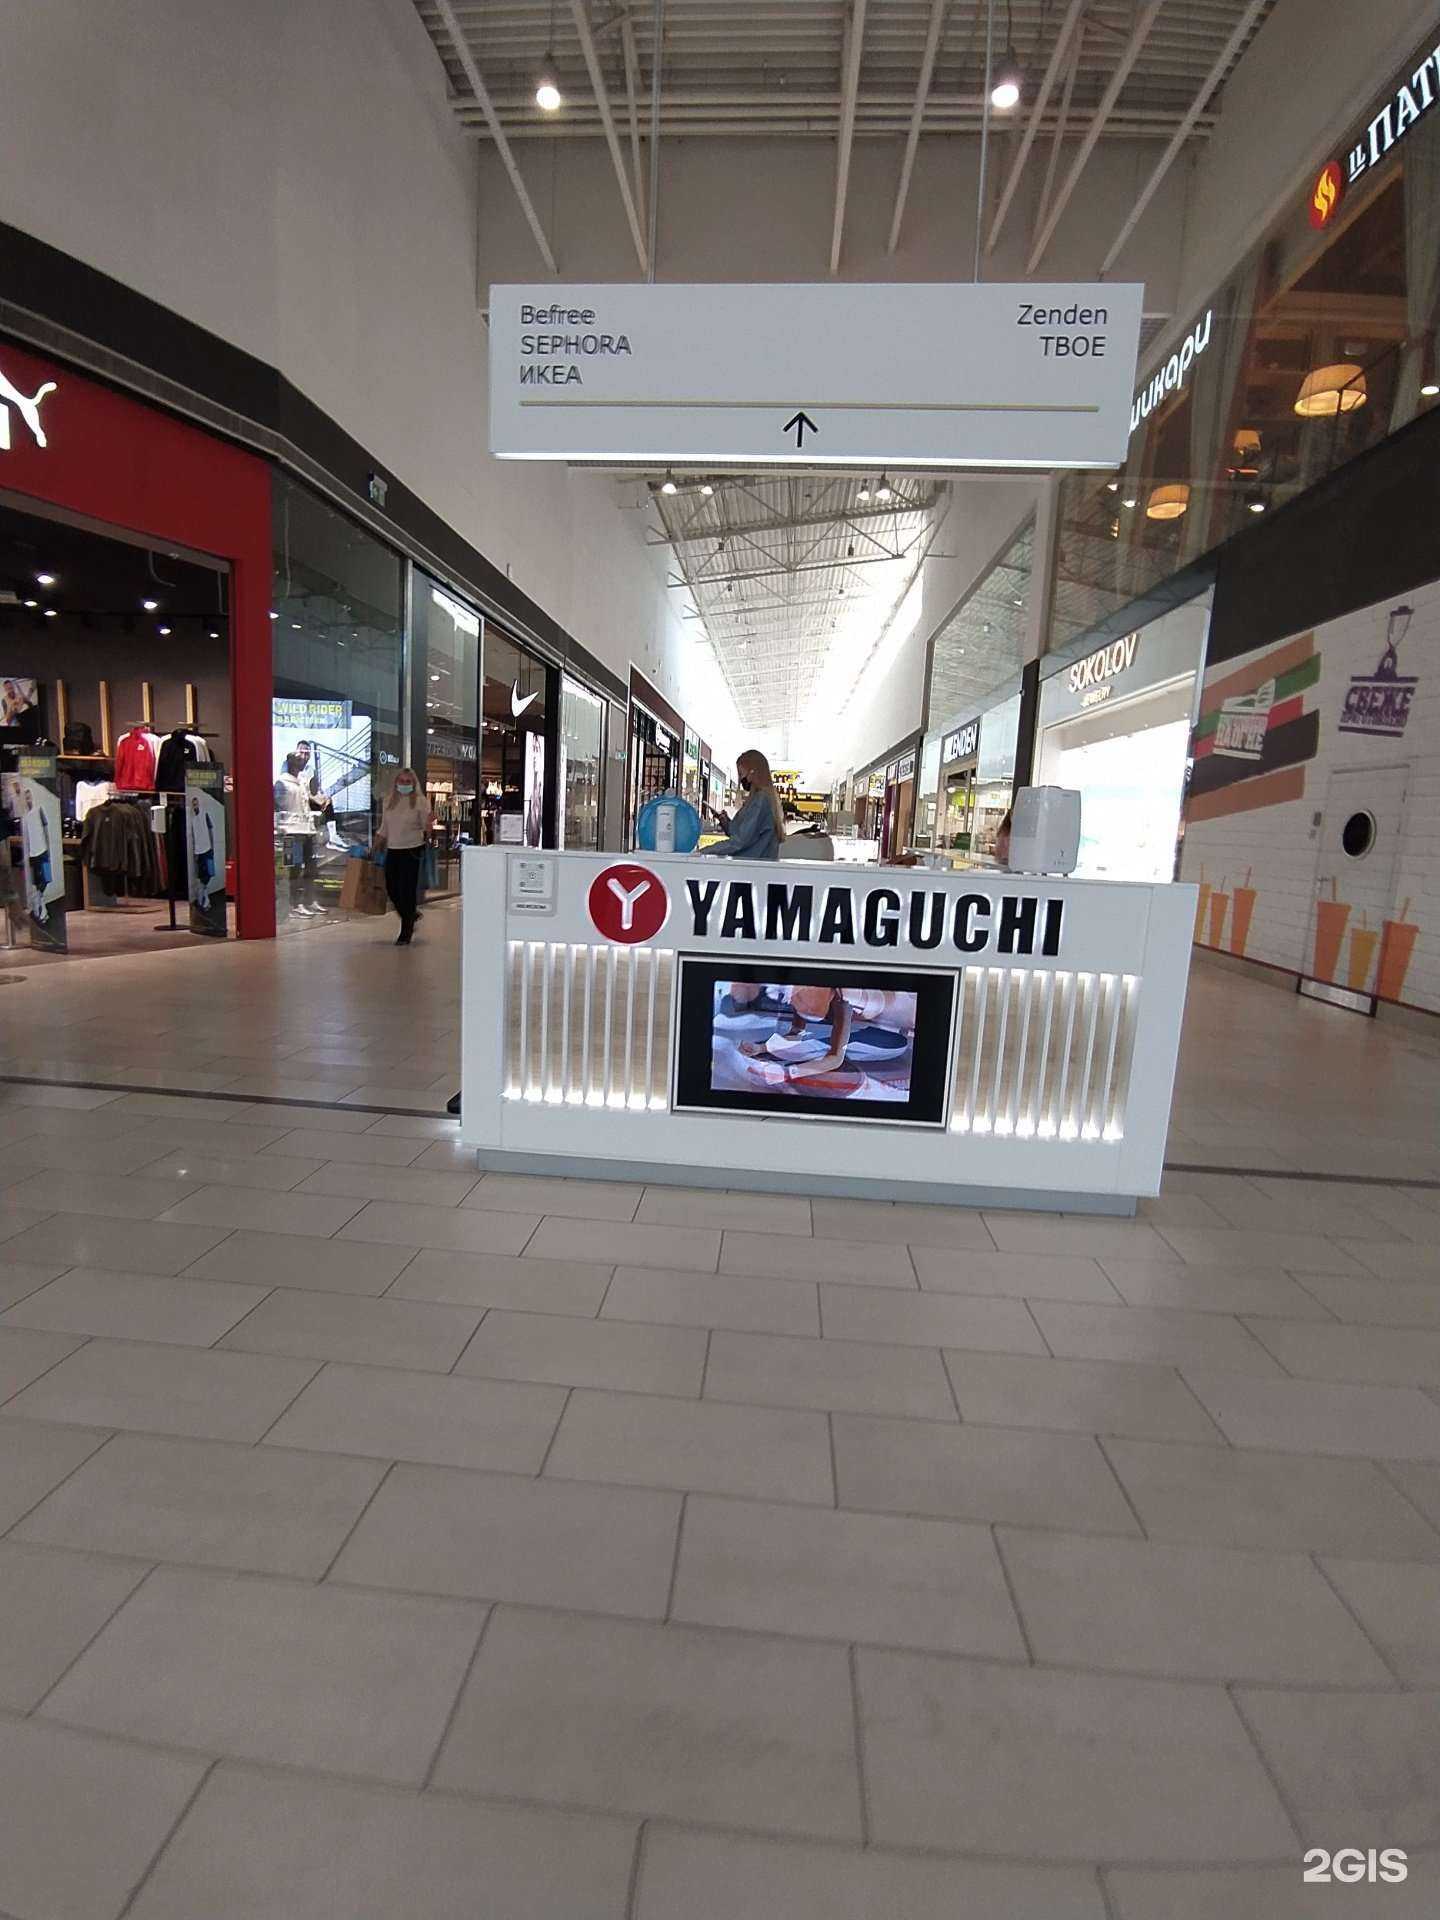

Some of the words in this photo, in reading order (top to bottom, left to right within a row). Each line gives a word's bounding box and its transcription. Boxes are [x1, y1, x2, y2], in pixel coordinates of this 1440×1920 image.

[521, 304, 596, 325] Befree
[1017, 304, 1107, 325] Zenden
[521, 334, 632, 355] SEPHORA
[1039, 336, 1106, 357] ТВОЕ
[520, 365, 583, 384] ИКЕА
[1069, 631, 1137, 693] SOKOLOV
[308, 704, 343, 715] RIDER
[685, 879, 1065, 956] YAMAGUCHI
